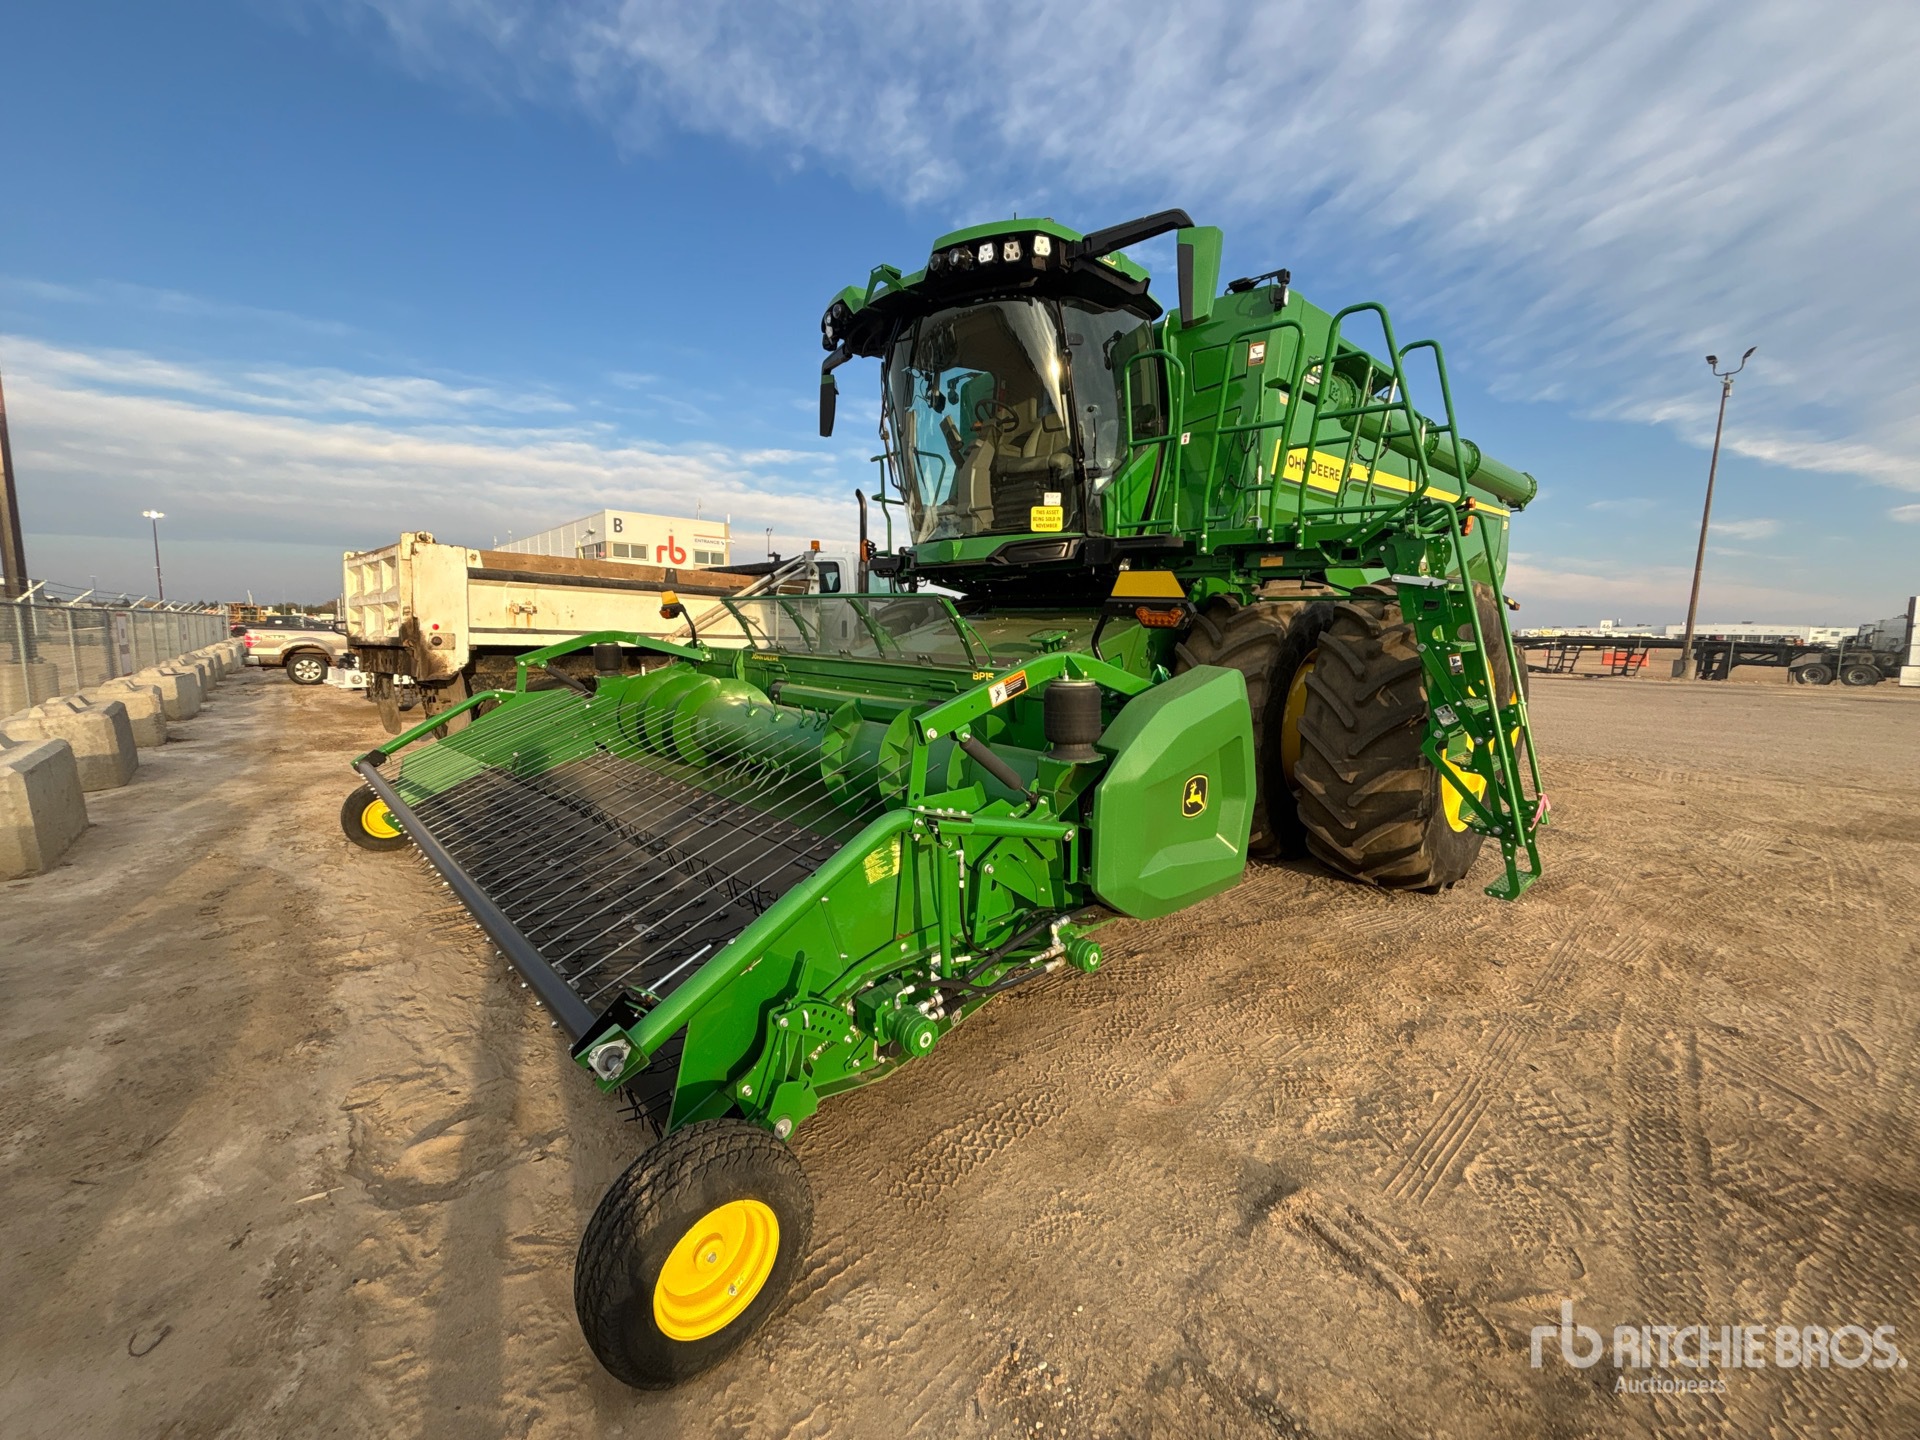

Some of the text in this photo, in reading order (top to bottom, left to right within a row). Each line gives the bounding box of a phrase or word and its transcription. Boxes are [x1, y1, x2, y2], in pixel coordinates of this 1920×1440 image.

[1288, 454, 1341, 482] OHN DEERE
[613, 517, 623, 533] B
[656, 535, 687, 565] rb
[694, 538, 721, 546] ENTRANCE
[973, 671, 994, 681] BP15
